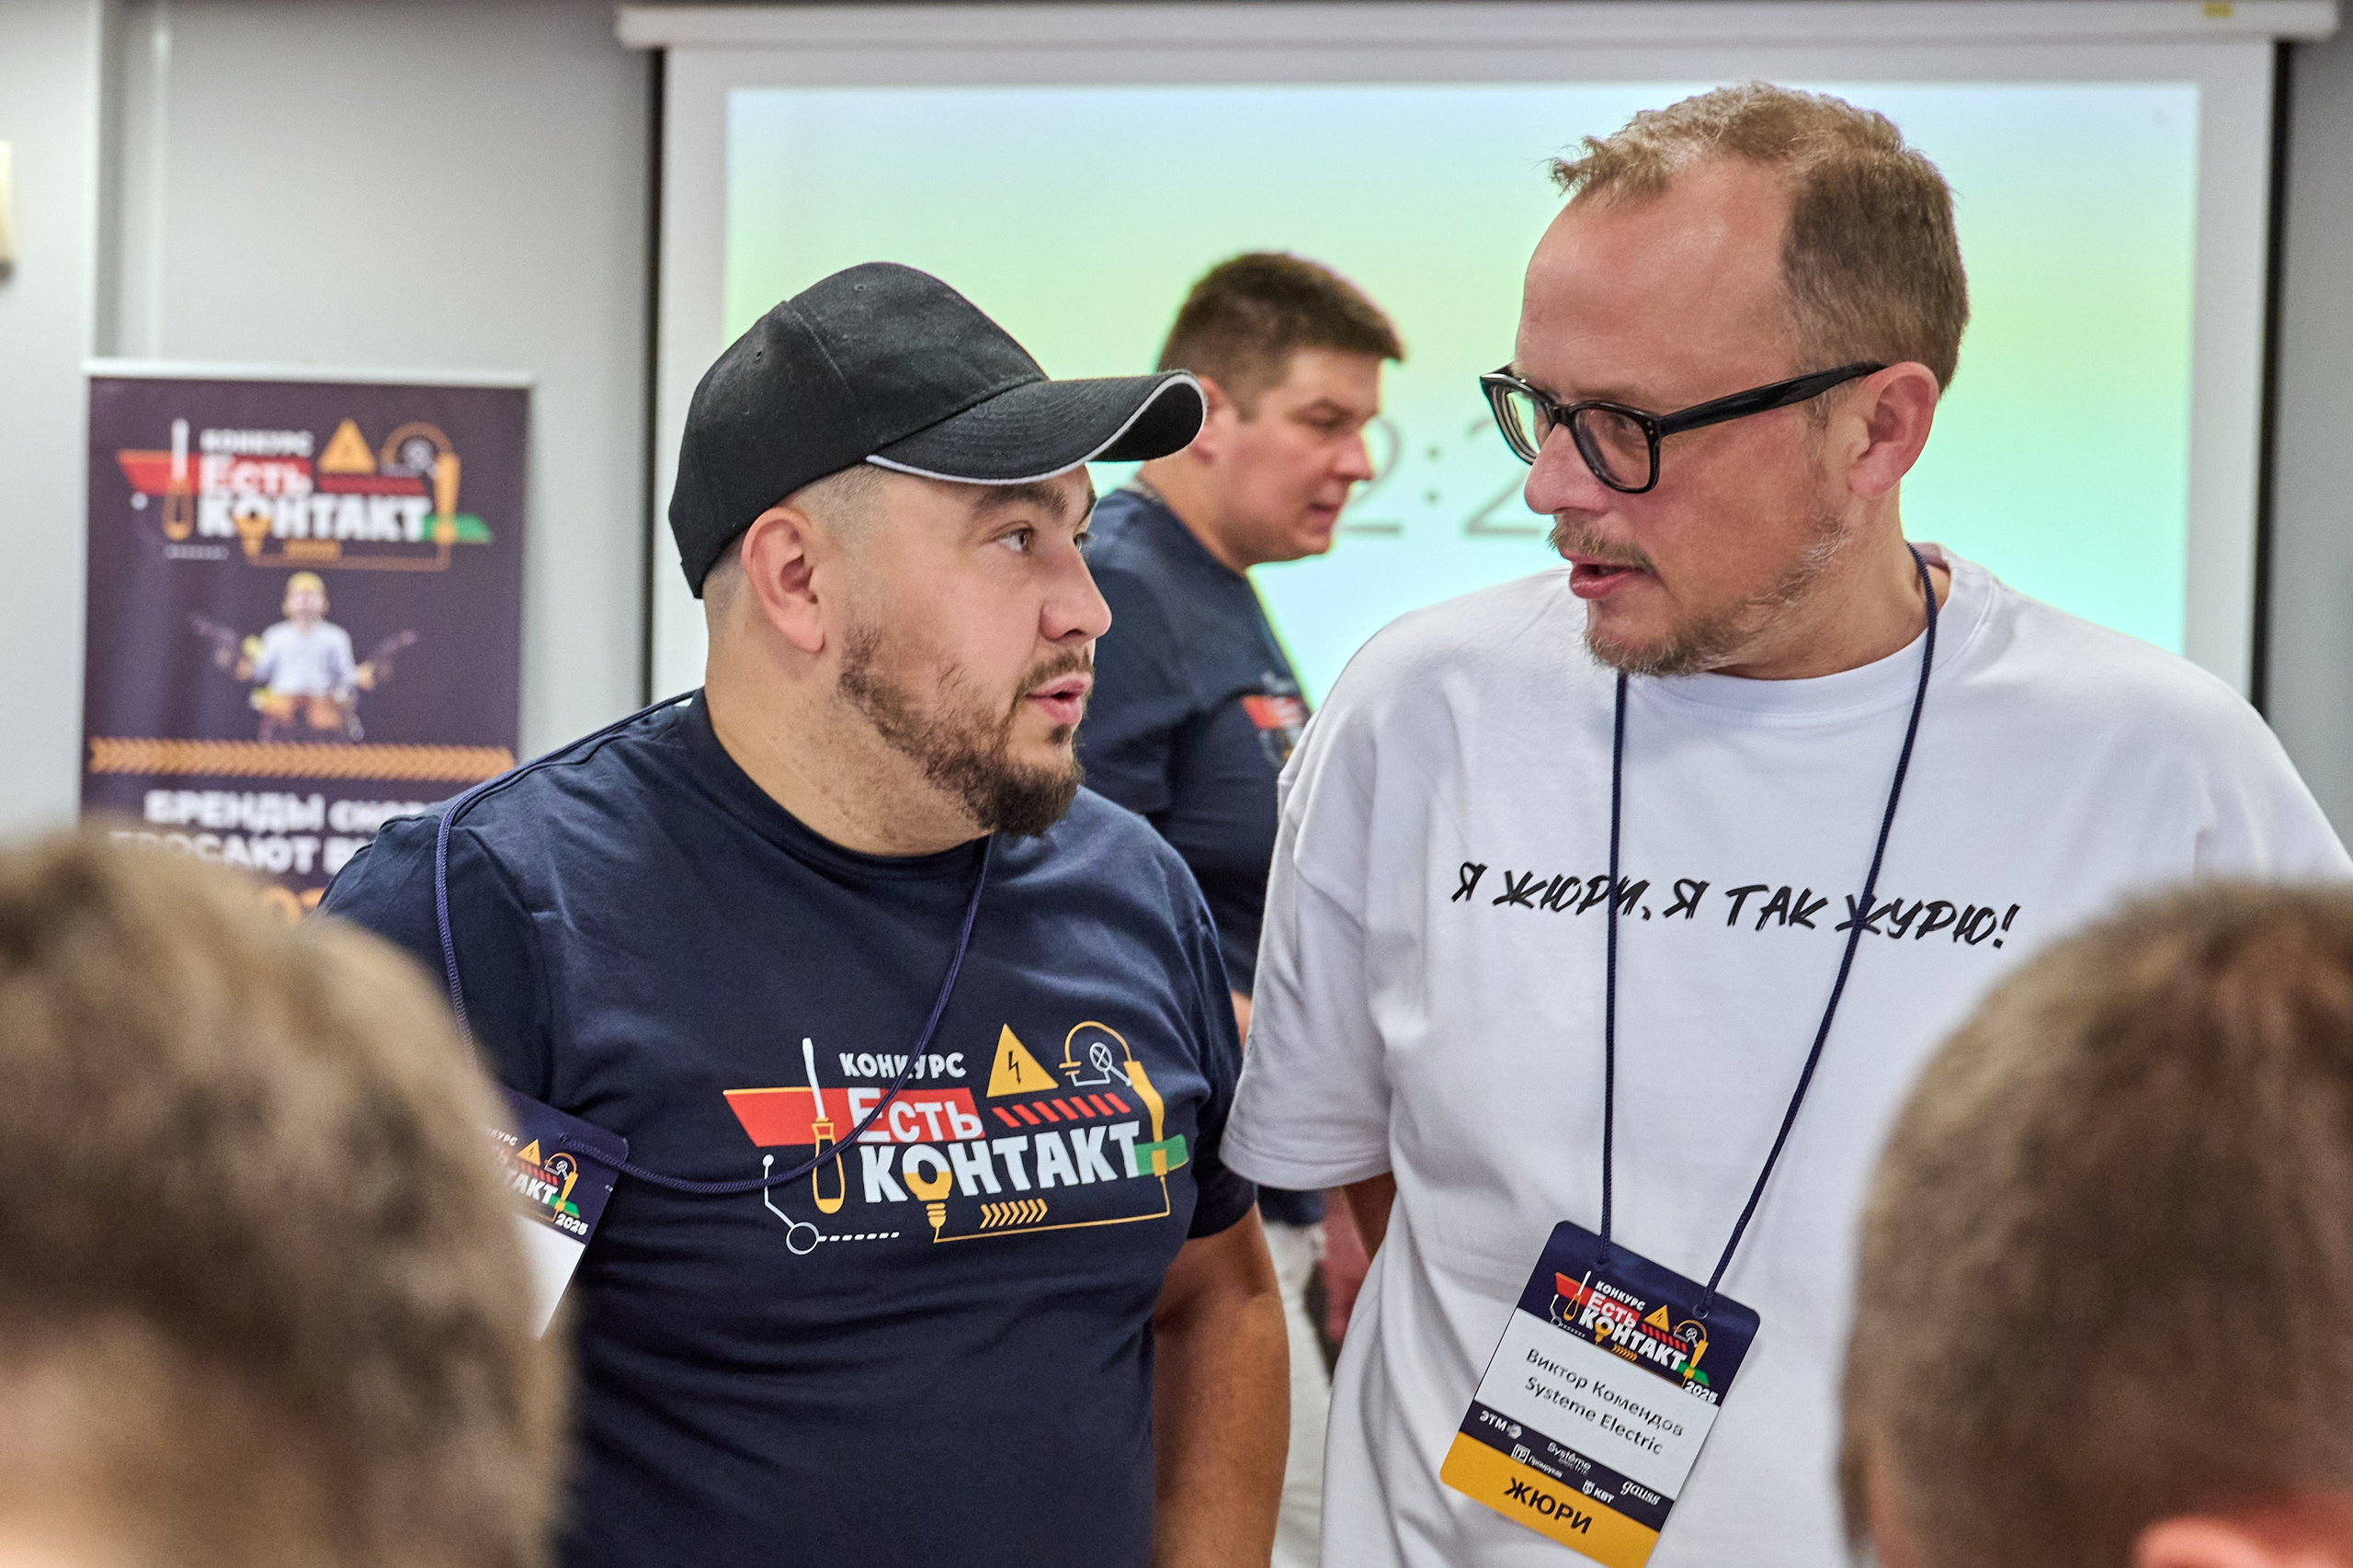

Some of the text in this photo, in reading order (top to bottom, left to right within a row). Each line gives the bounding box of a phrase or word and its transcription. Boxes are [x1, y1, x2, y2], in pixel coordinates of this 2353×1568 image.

[197, 493, 433, 541] КОНТАКТ
[144, 790, 325, 832] БРЕНДЫ
[1451, 862, 2021, 949] Я ЖЮРИ, Я ТАК ЖУРЮ!
[839, 1051, 967, 1080] КОНКУРС
[860, 1119, 1141, 1204] КОНТАКТ
[555, 1213, 588, 1235] 2025
[1595, 1280, 1646, 1312] КОНКУРС
[1578, 1308, 1688, 1371] КОНТАКТ
[1526, 1348, 1685, 1437] Виктор Комендов
[1686, 1381, 1719, 1403] 2025
[1479, 1410, 1508, 1432] ЭТМ
[1525, 1376, 1664, 1455] Systeme Electric
[1504, 1476, 1594, 1535] ЖЮРИ
[1620, 1480, 1662, 1506] gauss
